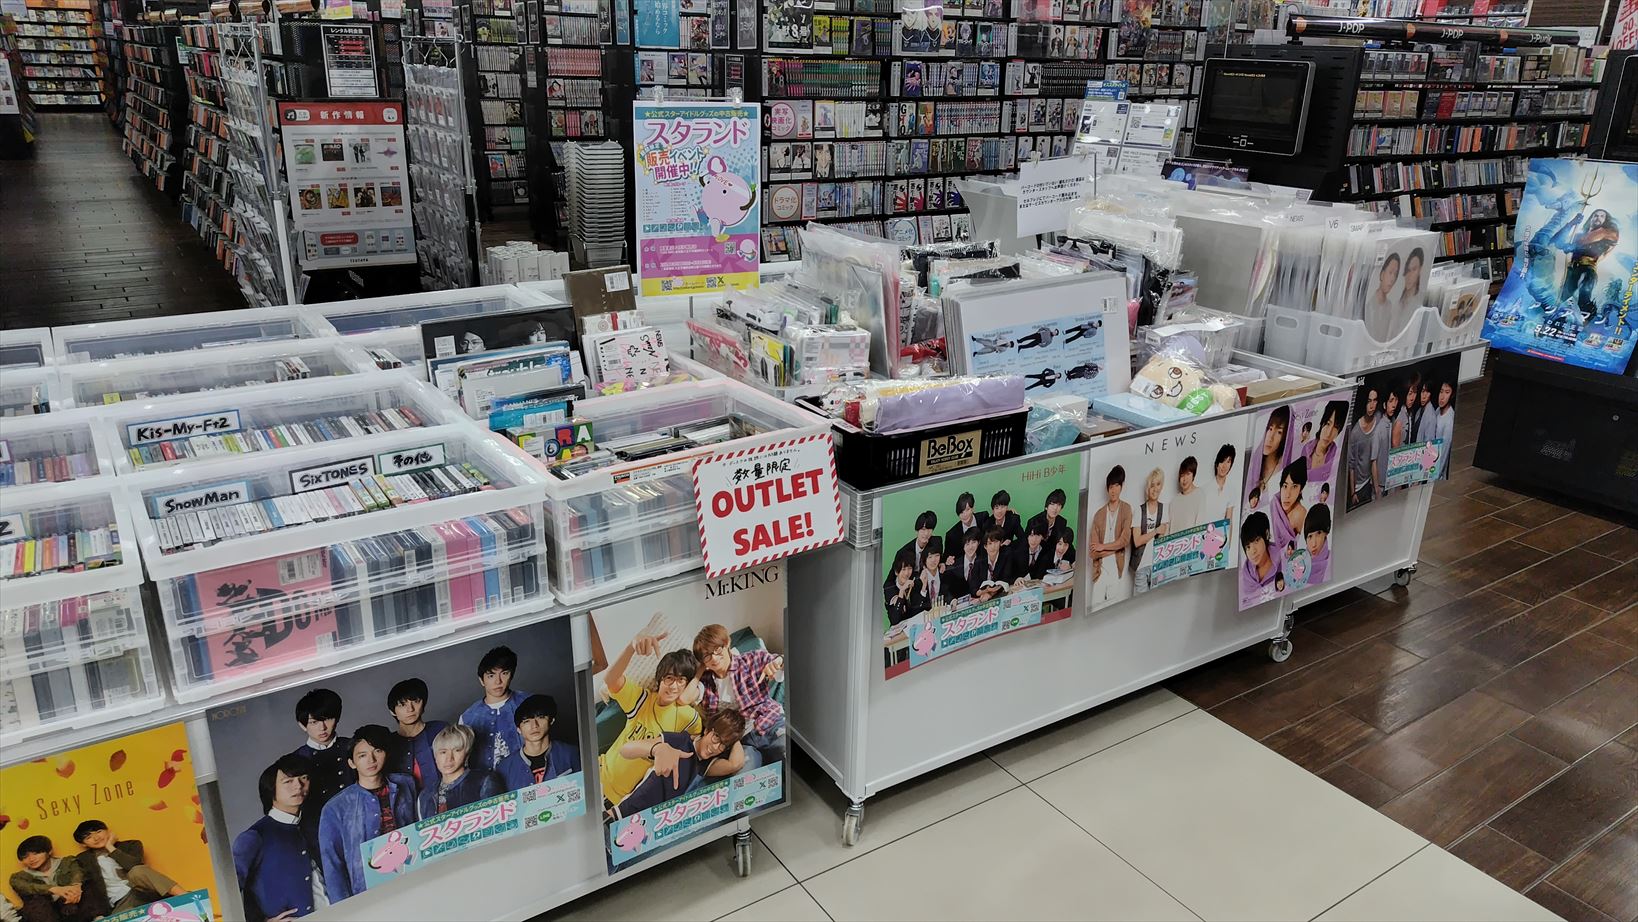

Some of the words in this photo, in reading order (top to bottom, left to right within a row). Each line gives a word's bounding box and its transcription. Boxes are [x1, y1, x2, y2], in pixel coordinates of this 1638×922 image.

[320, 110, 364, 120] 新作情報
[646, 119, 748, 146] スタランド
[646, 146, 705, 167] 販売イベント
[1328, 219, 1340, 230] V6
[136, 416, 230, 442] Kis-My-Ft2
[928, 436, 974, 458] BeBox
[1144, 432, 1198, 455] NEWS
[392, 450, 433, 468] その他
[732, 458, 792, 484] 数量限定
[298, 462, 370, 488] SixTONES
[712, 468, 824, 518] OUTLET
[733, 512, 815, 556] SALE!
[1154, 534, 1202, 562] スタランド
[942, 607, 999, 640] スタランド
[36, 792, 82, 820] Sexy
[90, 780, 136, 806] Zone
[654, 788, 730, 830] スタランド
[420, 801, 517, 848] スタランド
